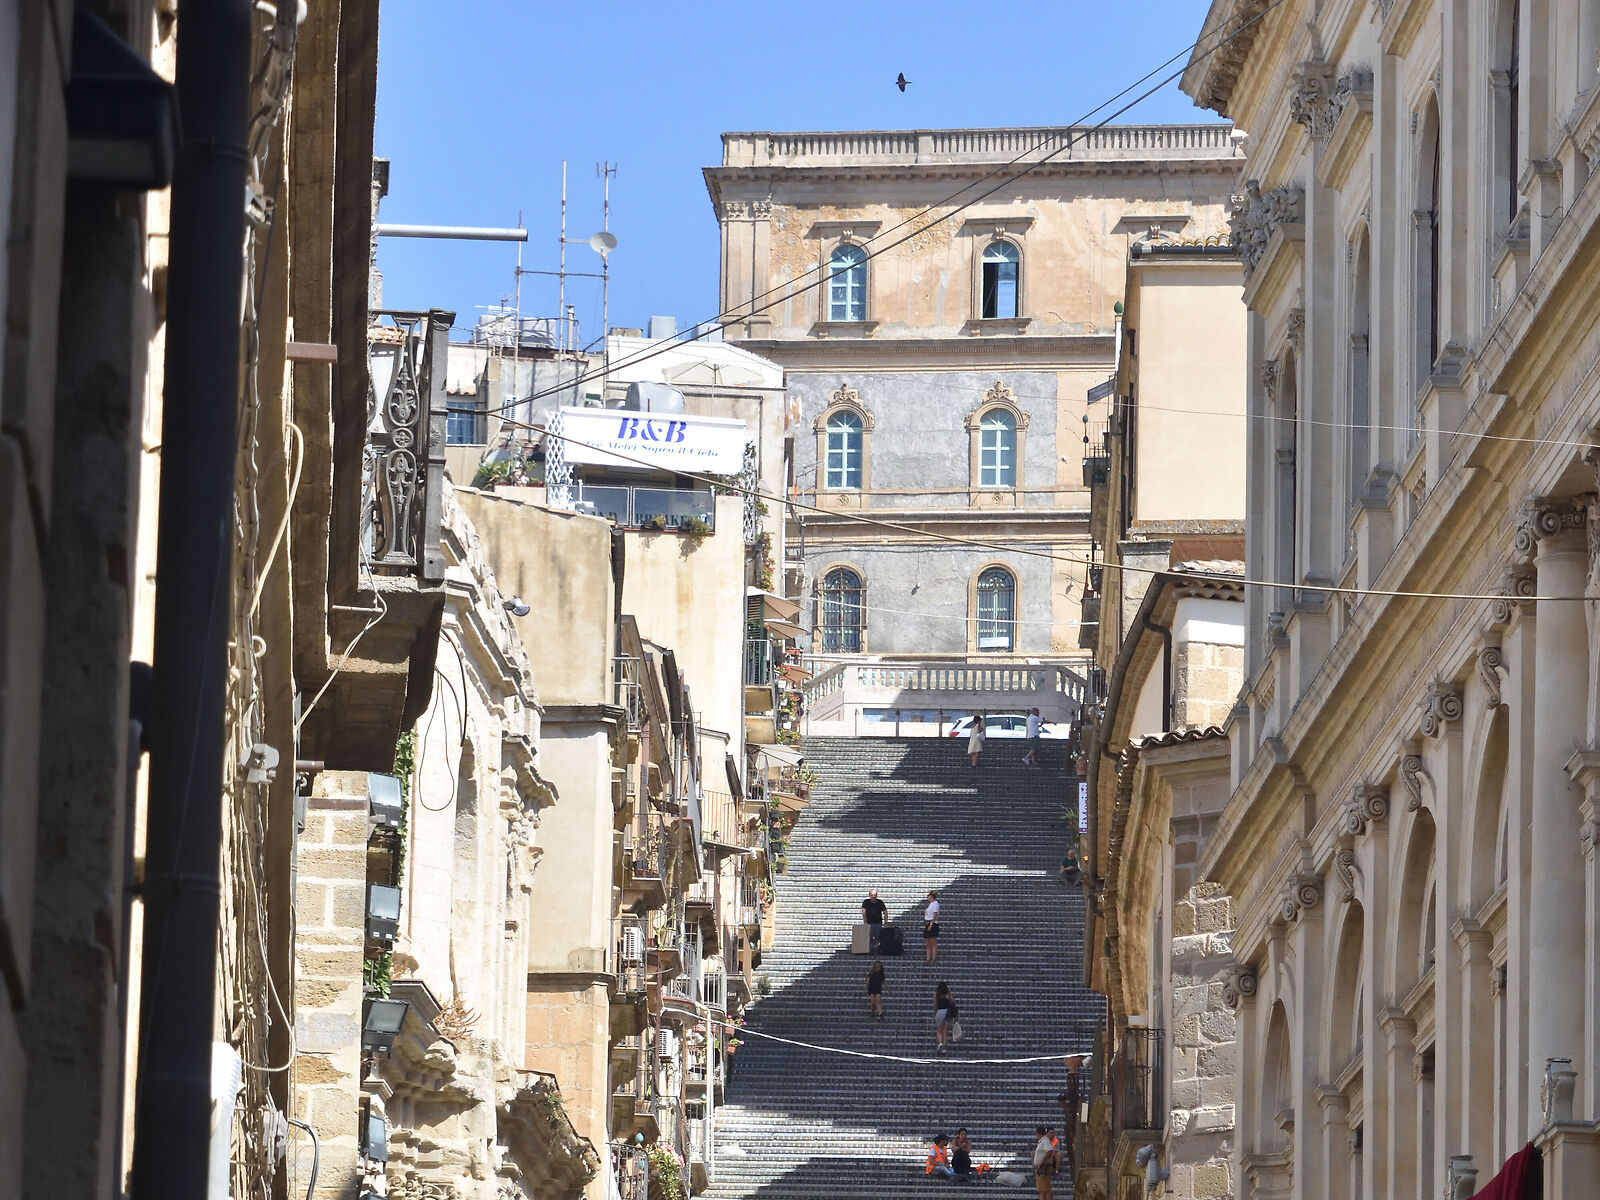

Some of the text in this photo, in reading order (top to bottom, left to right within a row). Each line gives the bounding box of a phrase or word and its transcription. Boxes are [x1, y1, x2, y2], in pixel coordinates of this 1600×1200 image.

[617, 418, 687, 443] B&B
[608, 441, 638, 451] Metri
[641, 444, 675, 455] Sopra
[689, 448, 719, 457] Cielo
